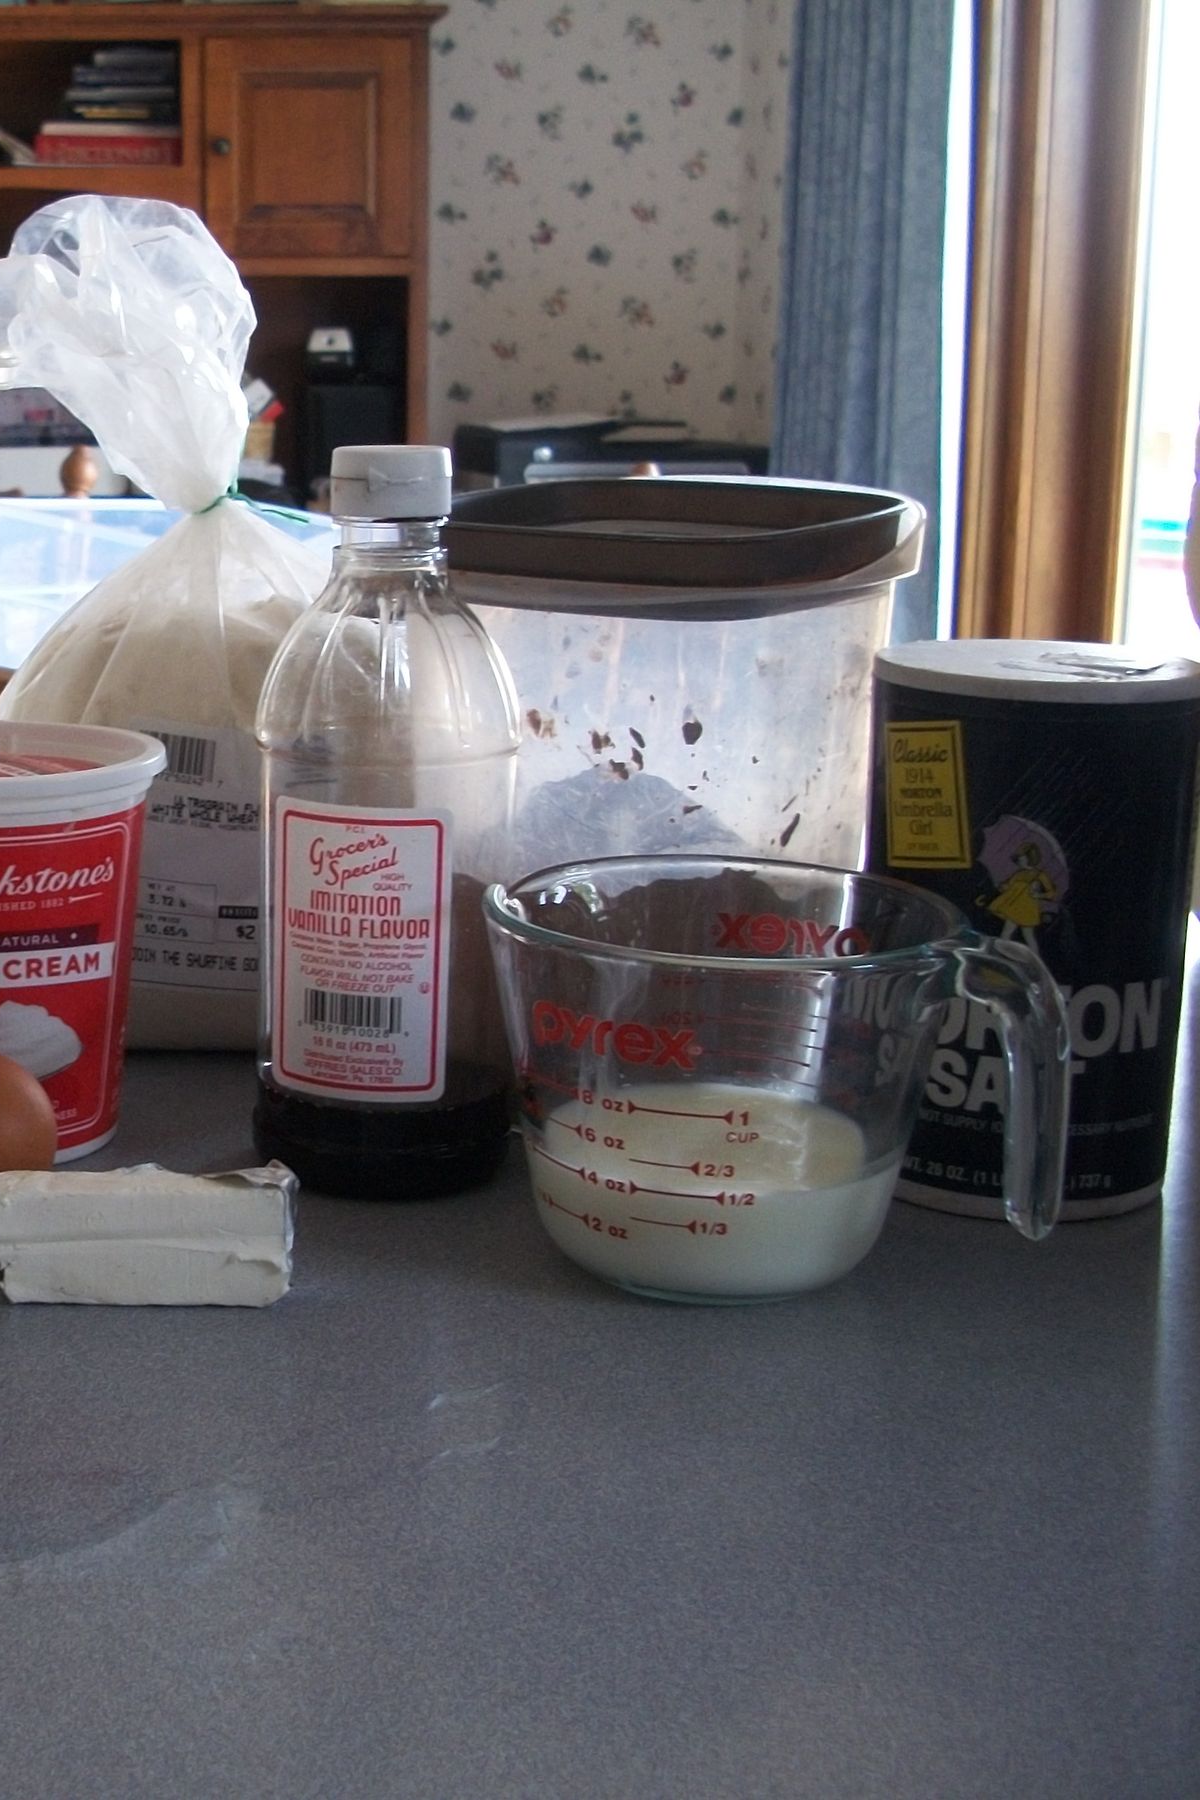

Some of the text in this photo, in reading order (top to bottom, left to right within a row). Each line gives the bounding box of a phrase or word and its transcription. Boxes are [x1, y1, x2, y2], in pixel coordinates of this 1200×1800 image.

[905, 767, 934, 783] 1914
[310, 833, 389, 876] Grocer's
[325, 847, 398, 890] Special
[310, 889, 401, 917] IMITATION
[288, 907, 351, 938] VANILLA
[358, 918, 430, 940] FLAVOR
[2, 951, 100, 981] CREAM
[365, 960, 412, 972] ALCOHOL
[332, 980, 369, 992] FREEZE
[372, 983, 396, 993] OUT
[362, 974, 384, 984] NOT
[386, 974, 414, 984] BAKE
[936, 976, 1162, 1060] ORON
[533, 1001, 696, 1070] pyrex
[349, 1065, 380, 1076] SALES
[579, 1089, 624, 1113] 8 oz
[738, 1111, 750, 1126] 1
[584, 1128, 625, 1151] 6 oz
[725, 1131, 760, 1144] CUP
[704, 1163, 735, 1178] 2/3
[926, 1160, 943, 1176] 26
[587, 1171, 627, 1193] 4 oz
[729, 1193, 754, 1206] 1/2
[591, 1218, 628, 1240] 2 oz
[700, 1221, 728, 1236] 1/3
